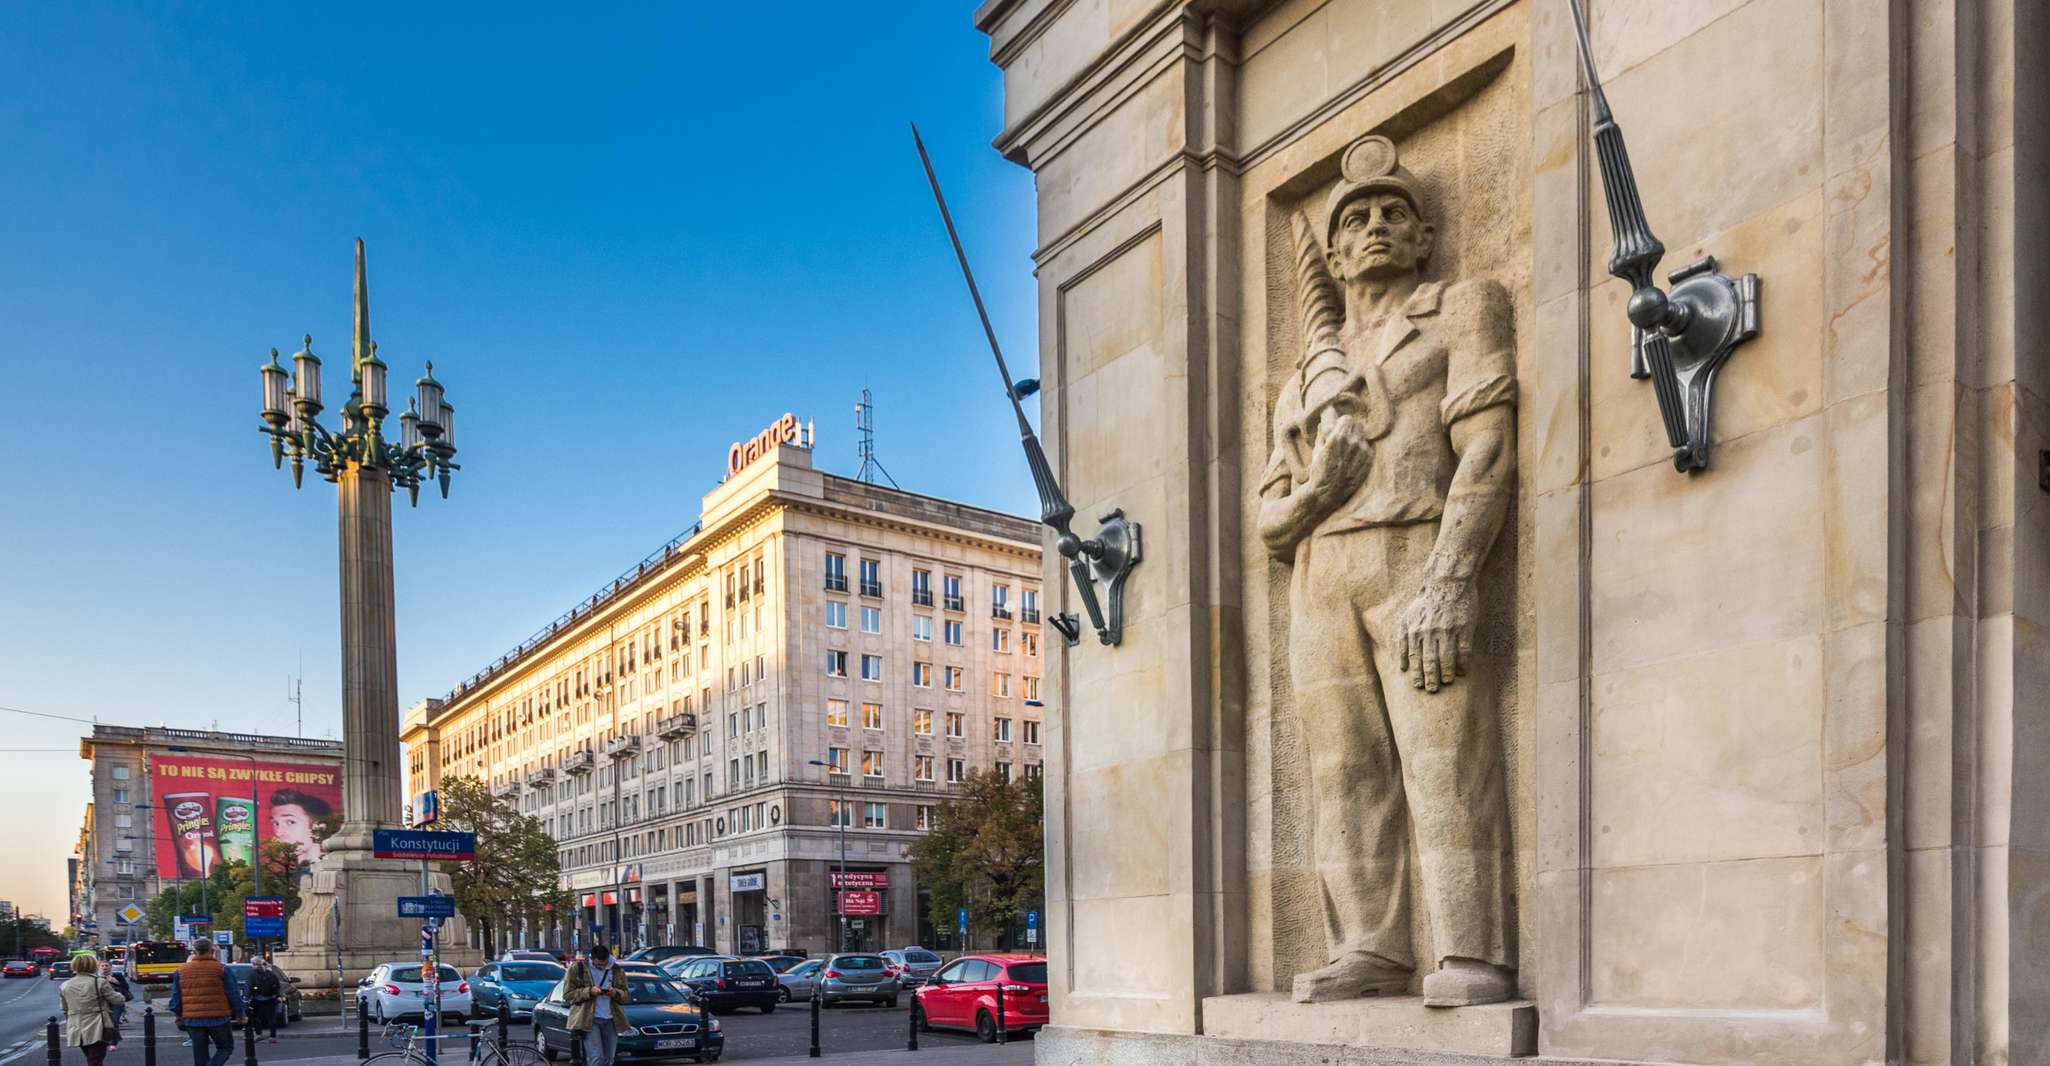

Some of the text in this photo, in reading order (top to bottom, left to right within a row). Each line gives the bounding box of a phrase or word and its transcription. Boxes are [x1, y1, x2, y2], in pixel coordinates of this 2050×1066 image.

[728, 412, 795, 477] Orange
[159, 764, 335, 785] TO NIE SĄ ZWYKŁE CHIPSY
[176, 816, 210, 835] Pringles
[219, 820, 252, 833] Pringles
[390, 837, 460, 853] Konstytucji
